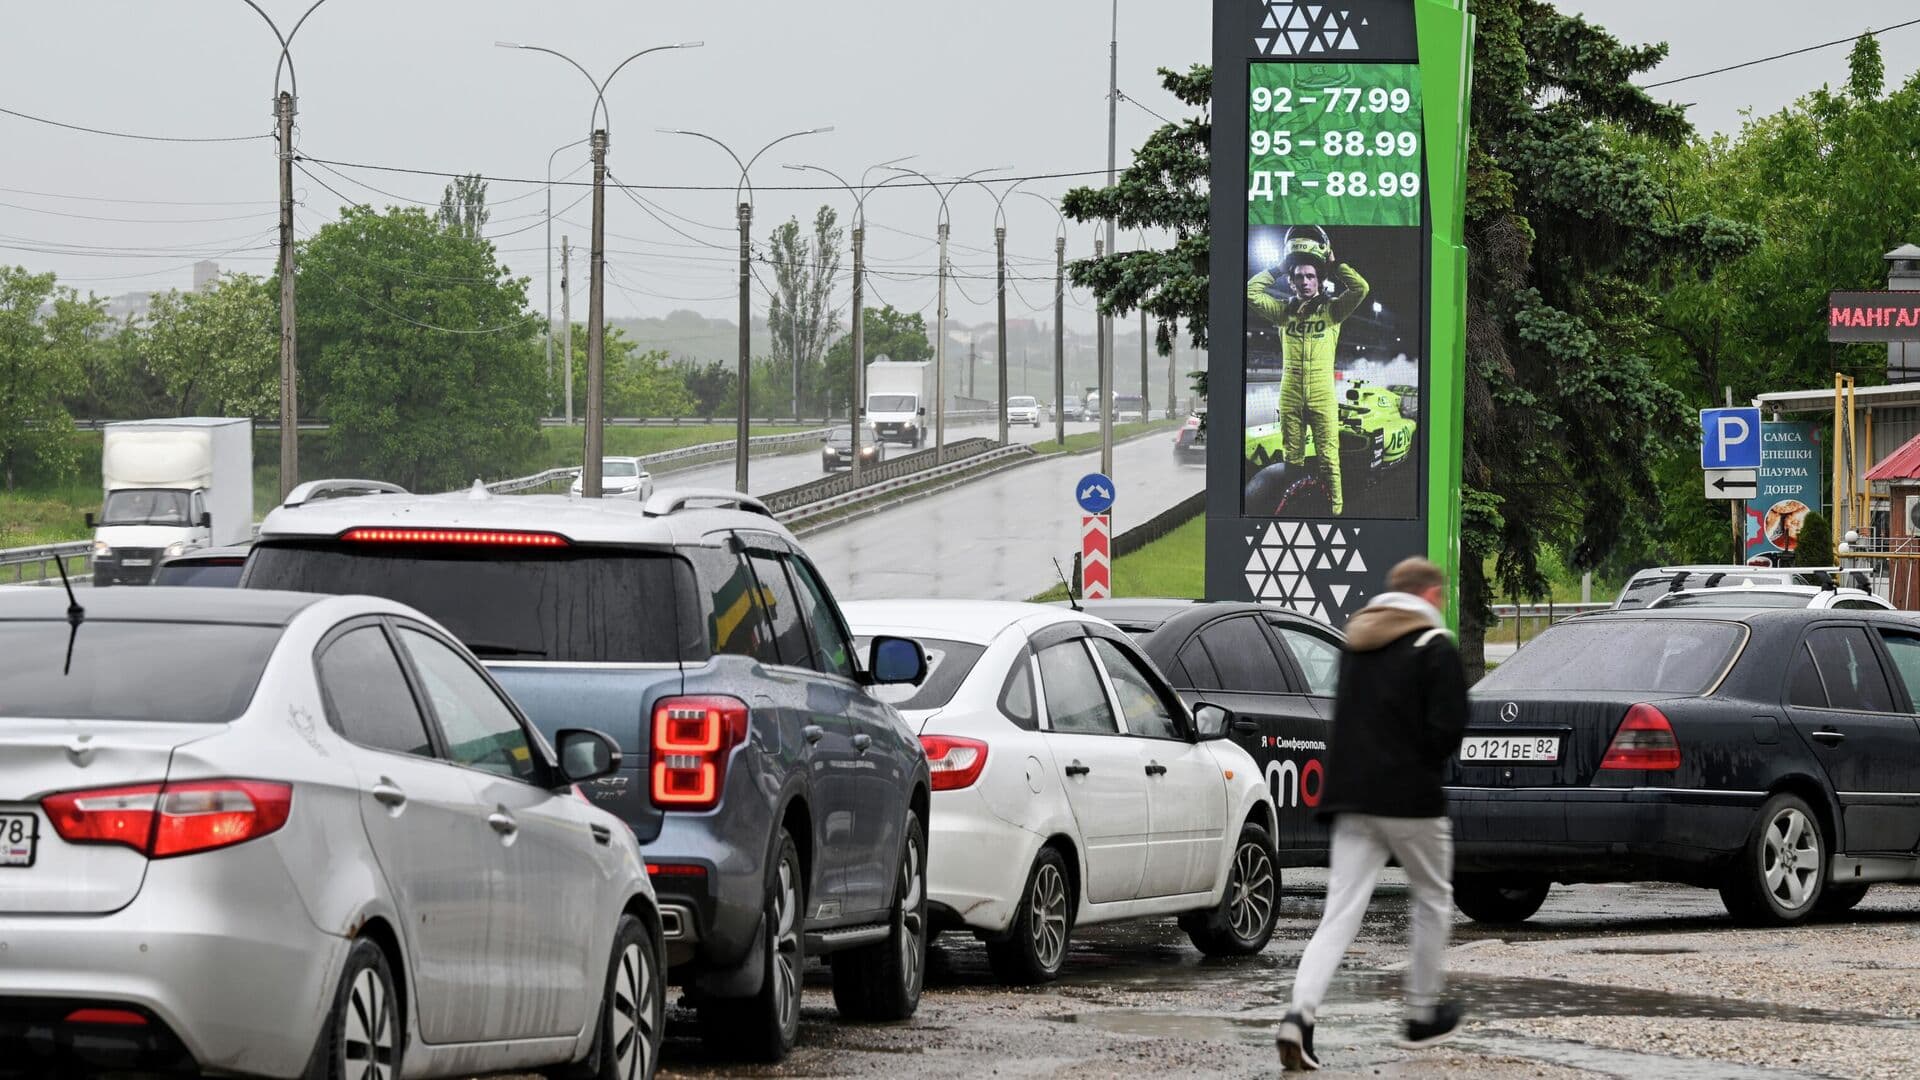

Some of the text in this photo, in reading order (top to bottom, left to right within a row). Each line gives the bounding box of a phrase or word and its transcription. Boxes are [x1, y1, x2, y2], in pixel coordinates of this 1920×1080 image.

[1252, 87, 1292, 112] 92
[1323, 88, 1410, 113] 77.99
[1250, 130, 1291, 156] 95
[1323, 131, 1417, 156] 88.99
[1248, 171, 1295, 201] ДТ
[1326, 172, 1420, 197] 88.99
[1763, 432, 1802, 442] САМСА
[1762, 449, 1812, 459] ЕПЕШКИ
[1759, 467, 1808, 477] ШАУРМА
[1763, 485, 1803, 496] ДОНЕР
[1261, 735, 1327, 751] Я Симферополь
[1536, 739, 1553, 754] 82
[0, 819, 23, 844] 78
